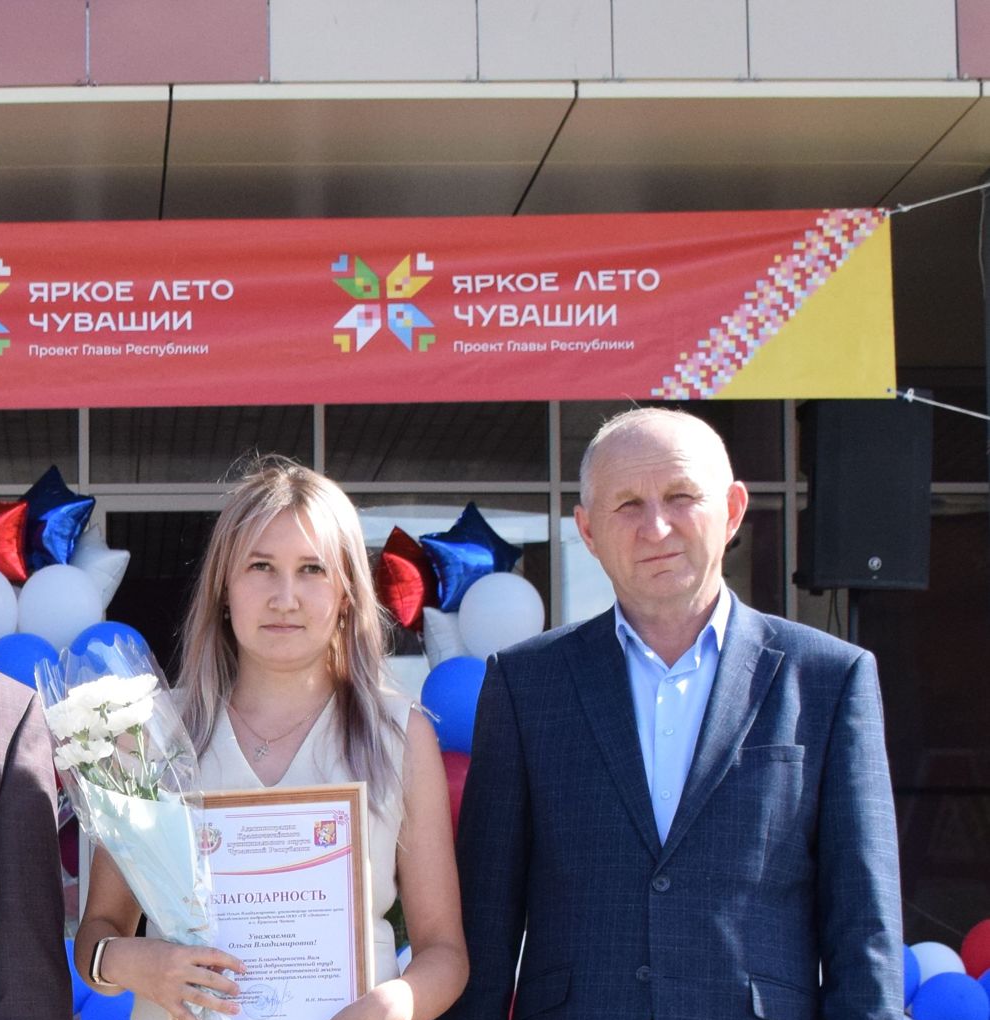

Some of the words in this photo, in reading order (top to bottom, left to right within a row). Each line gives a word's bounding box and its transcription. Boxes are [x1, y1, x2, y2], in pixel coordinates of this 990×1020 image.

[28, 280, 134, 303] ЯРКОЕ
[148, 278, 234, 301] ЛЕТО
[452, 272, 560, 294] ЯРКОЕ
[573, 268, 661, 292] ЛЕТО
[28, 310, 193, 333] ЧУВАШИИ
[453, 303, 618, 328] ЧУВАШИИ
[28, 344, 79, 359] Проект
[82, 343, 122, 356] Главы
[125, 342, 209, 358] Республики
[453, 340, 505, 355] Проект
[506, 339, 548, 352] Главы
[550, 338, 635, 353] Республики
[210, 889, 327, 905] БЛАГОДАРНОСТЬ
